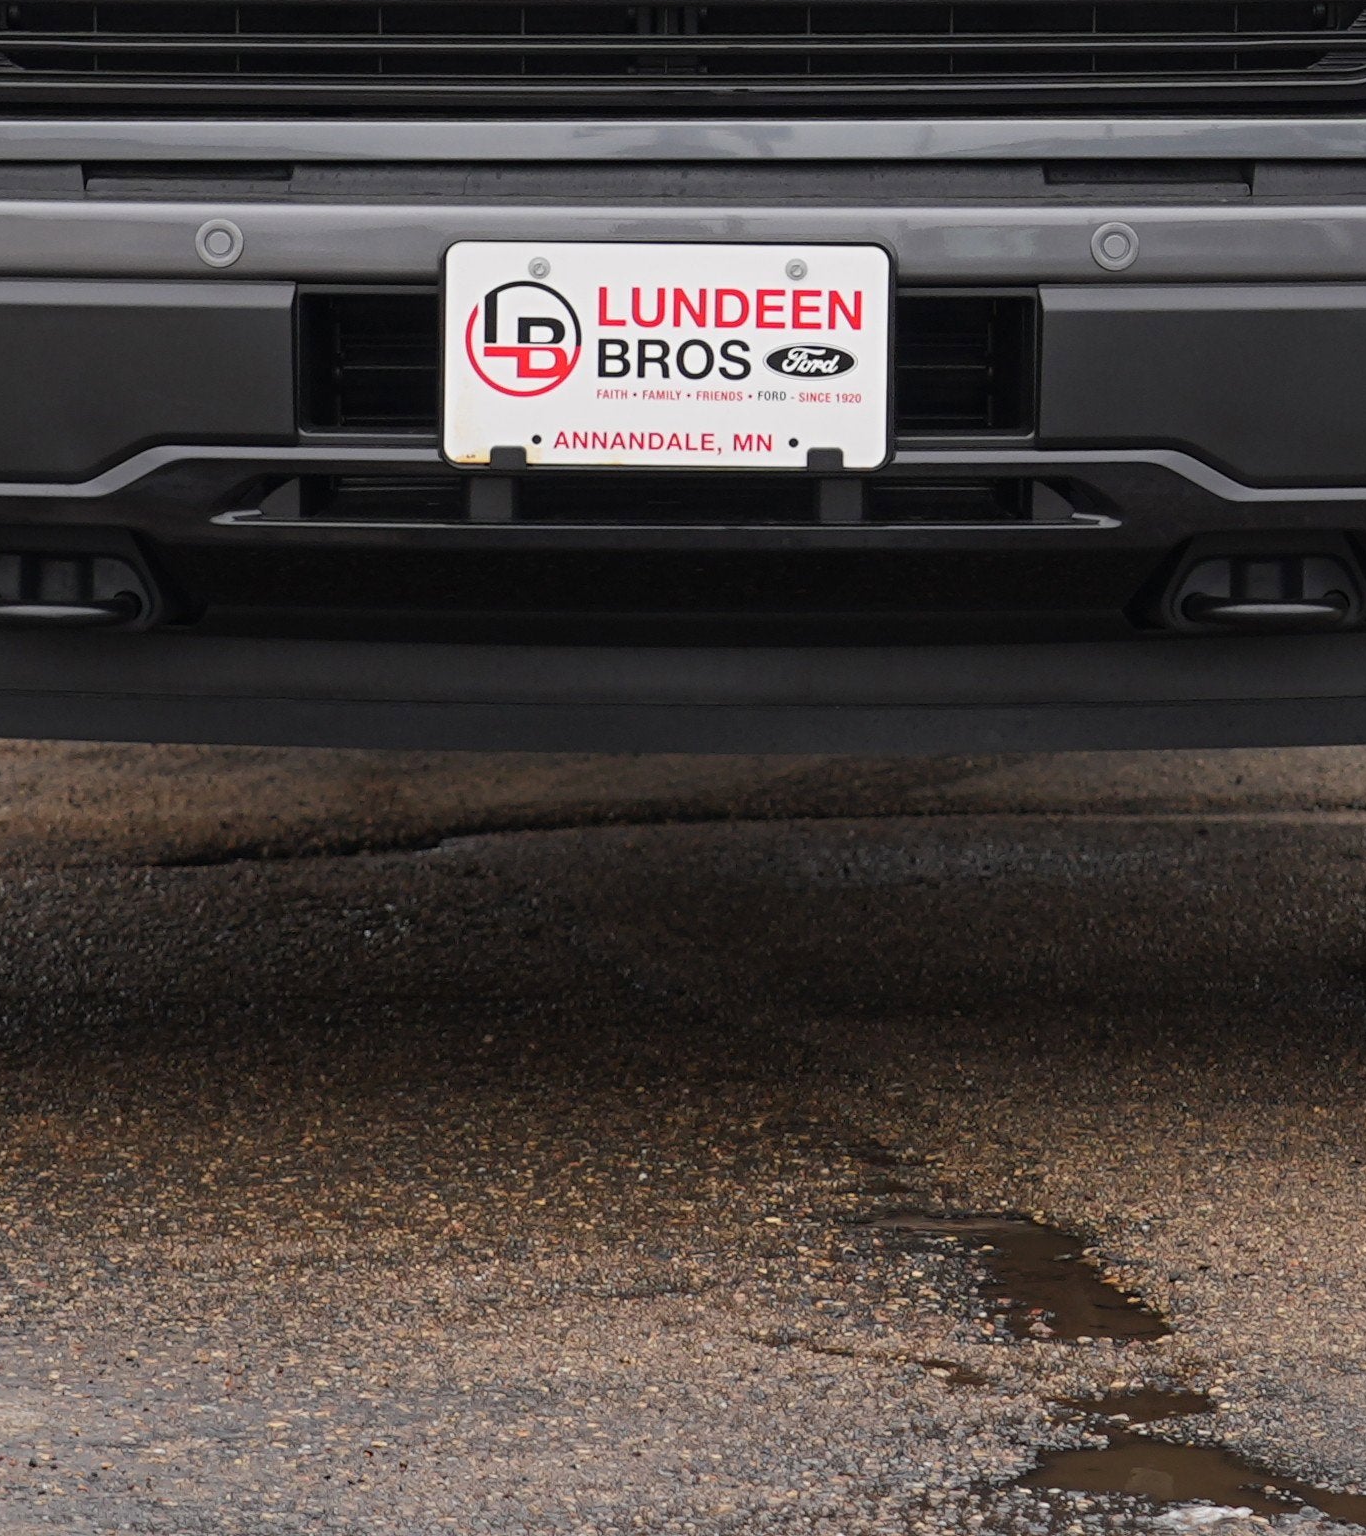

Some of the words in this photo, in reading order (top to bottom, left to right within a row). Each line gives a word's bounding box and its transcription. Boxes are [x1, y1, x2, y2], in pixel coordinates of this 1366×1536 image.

[597, 286, 863, 330] LUNDEEN
[597, 338, 752, 381] BROS
[781, 346, 839, 375] Ford
[596, 389, 628, 400] FAITH
[642, 389, 682, 401] FAMILY
[696, 390, 743, 402] FRIENDS
[757, 390, 787, 402] FORD
[798, 392, 831, 403] SINCE
[836, 392, 862, 403] 1920
[553, 430, 722, 455] ANNANDALE,
[733, 433, 773, 453] MN
